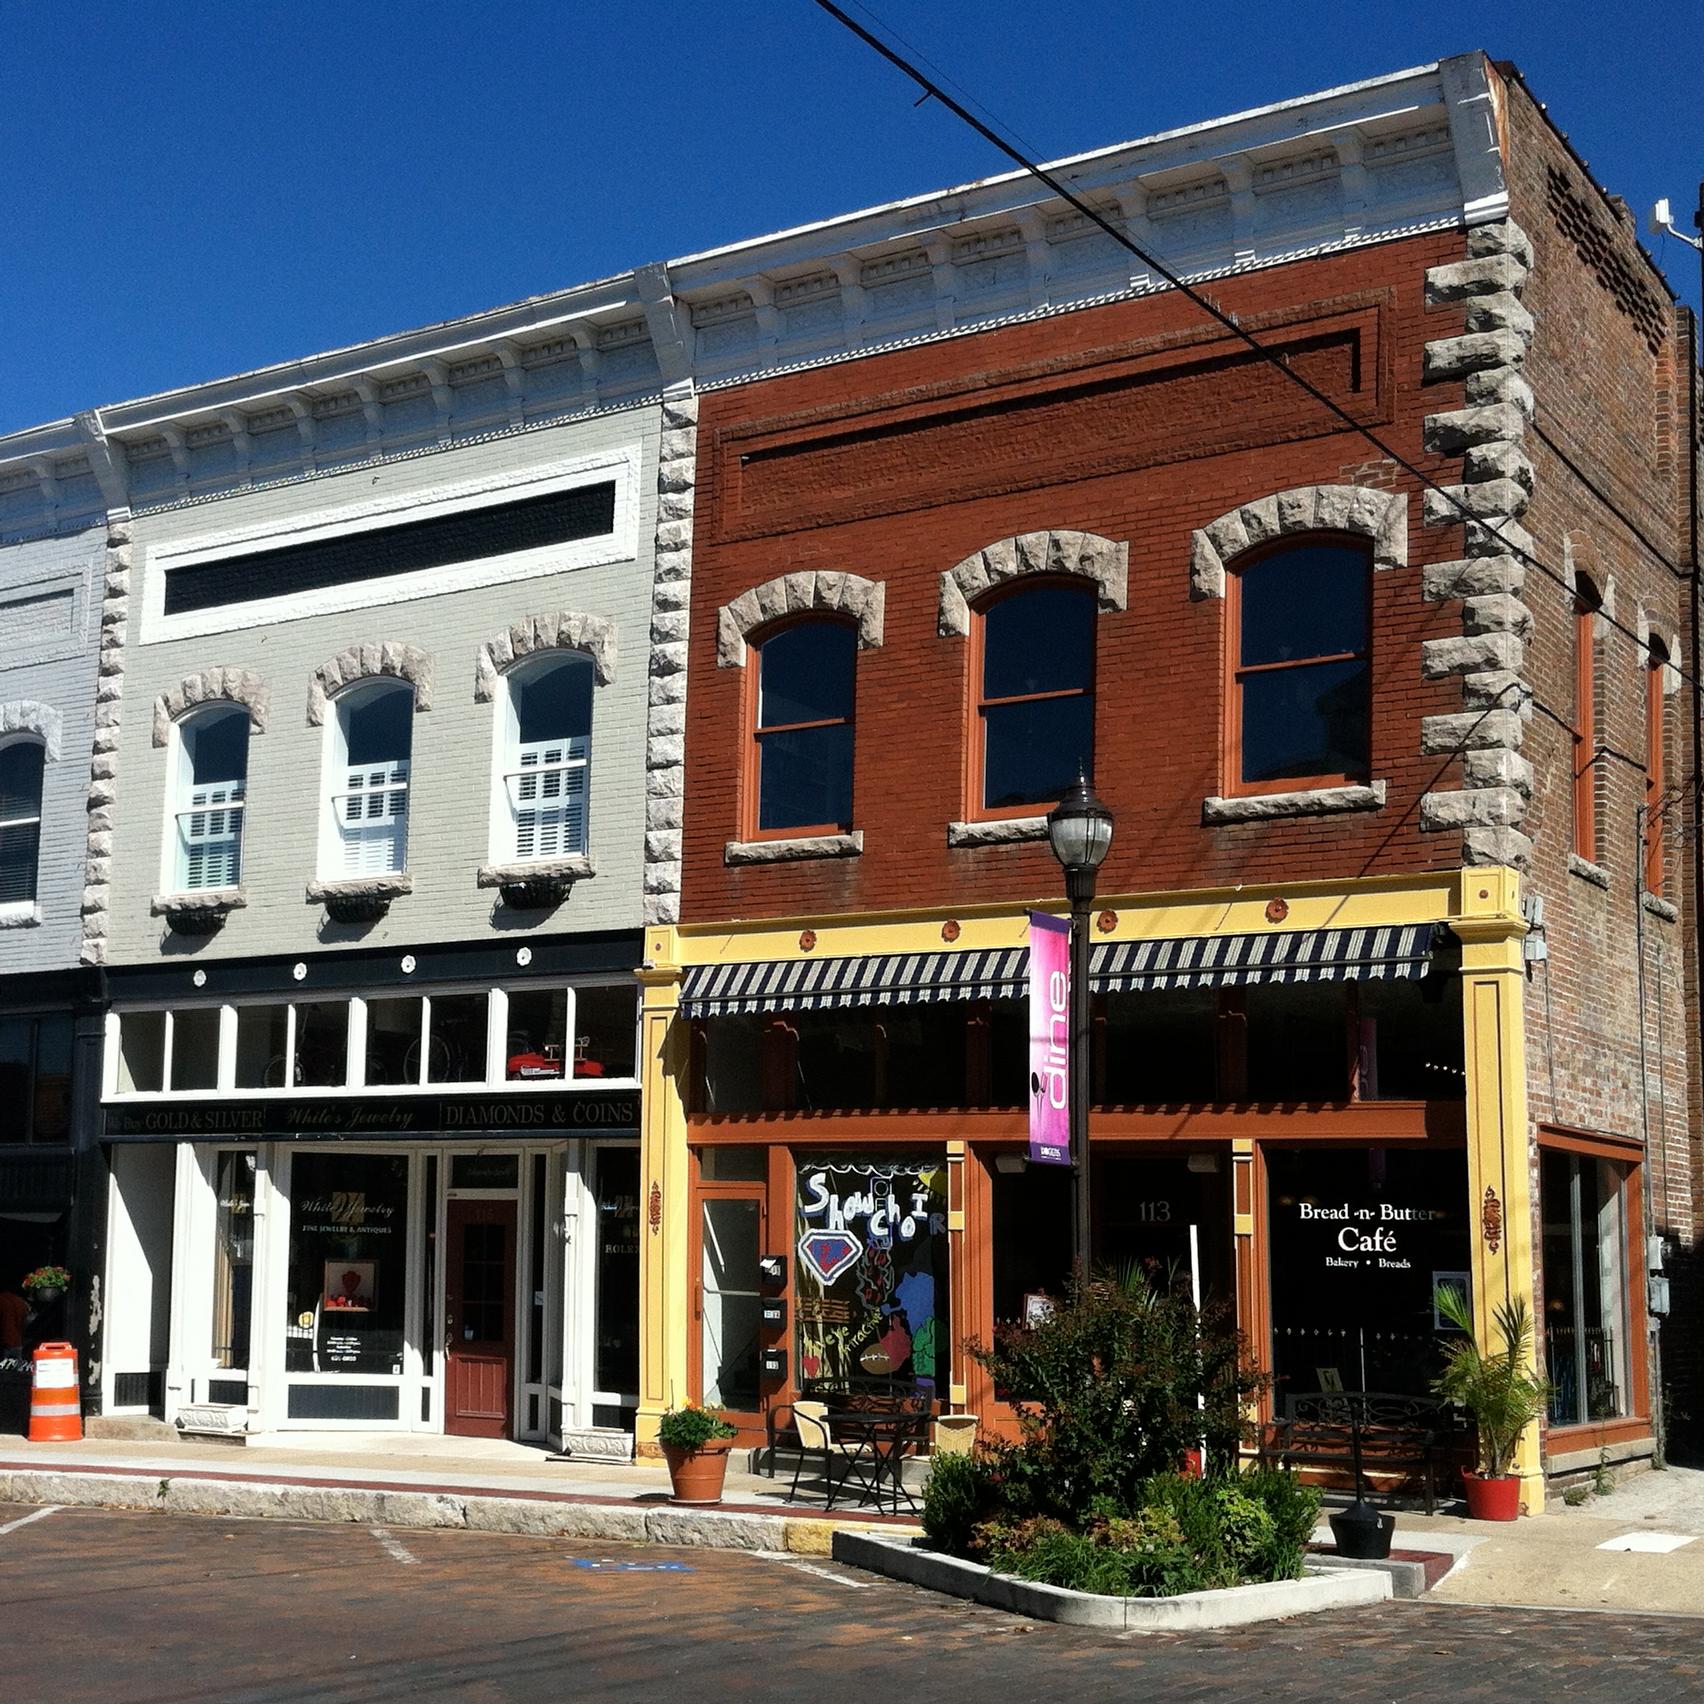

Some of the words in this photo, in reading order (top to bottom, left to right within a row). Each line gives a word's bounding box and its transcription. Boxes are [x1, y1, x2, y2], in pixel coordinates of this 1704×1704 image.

[1043, 970, 1067, 1110] dine
[445, 1103, 545, 1126] DIAMONDS
[551, 1103, 567, 1124] &
[572, 1102, 634, 1124] COINS
[1138, 1200, 1172, 1223] 113
[1298, 1202, 1350, 1220] Bread
[1379, 1203, 1435, 1221] Butter
[1337, 1226, 1398, 1253] Café
[1325, 1257, 1359, 1269] Bakery
[1378, 1258, 1412, 1269] Breads
